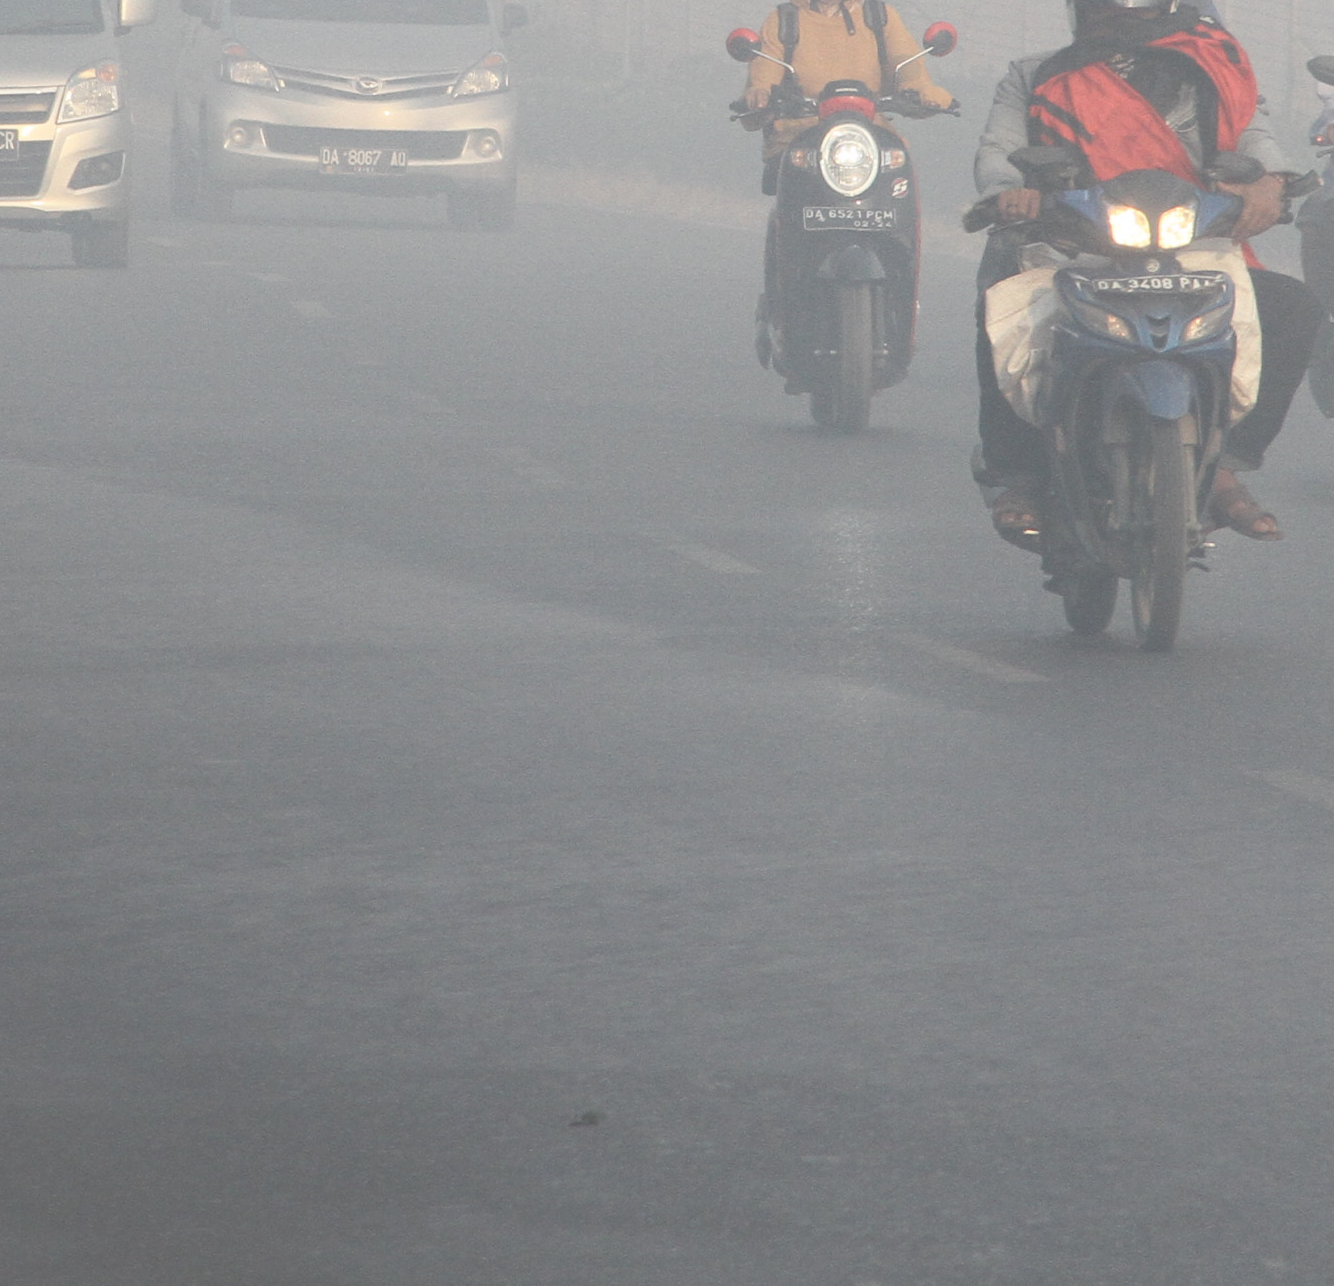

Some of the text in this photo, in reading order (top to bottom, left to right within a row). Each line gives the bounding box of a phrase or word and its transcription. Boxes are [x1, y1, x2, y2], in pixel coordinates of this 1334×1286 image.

[322, 148, 340, 165] DA
[347, 149, 382, 166] 8067
[806, 209, 823, 220] DA
[828, 209, 862, 219] 6521
[1098, 280, 1123, 291] DA
[1128, 278, 1174, 291] 3408
